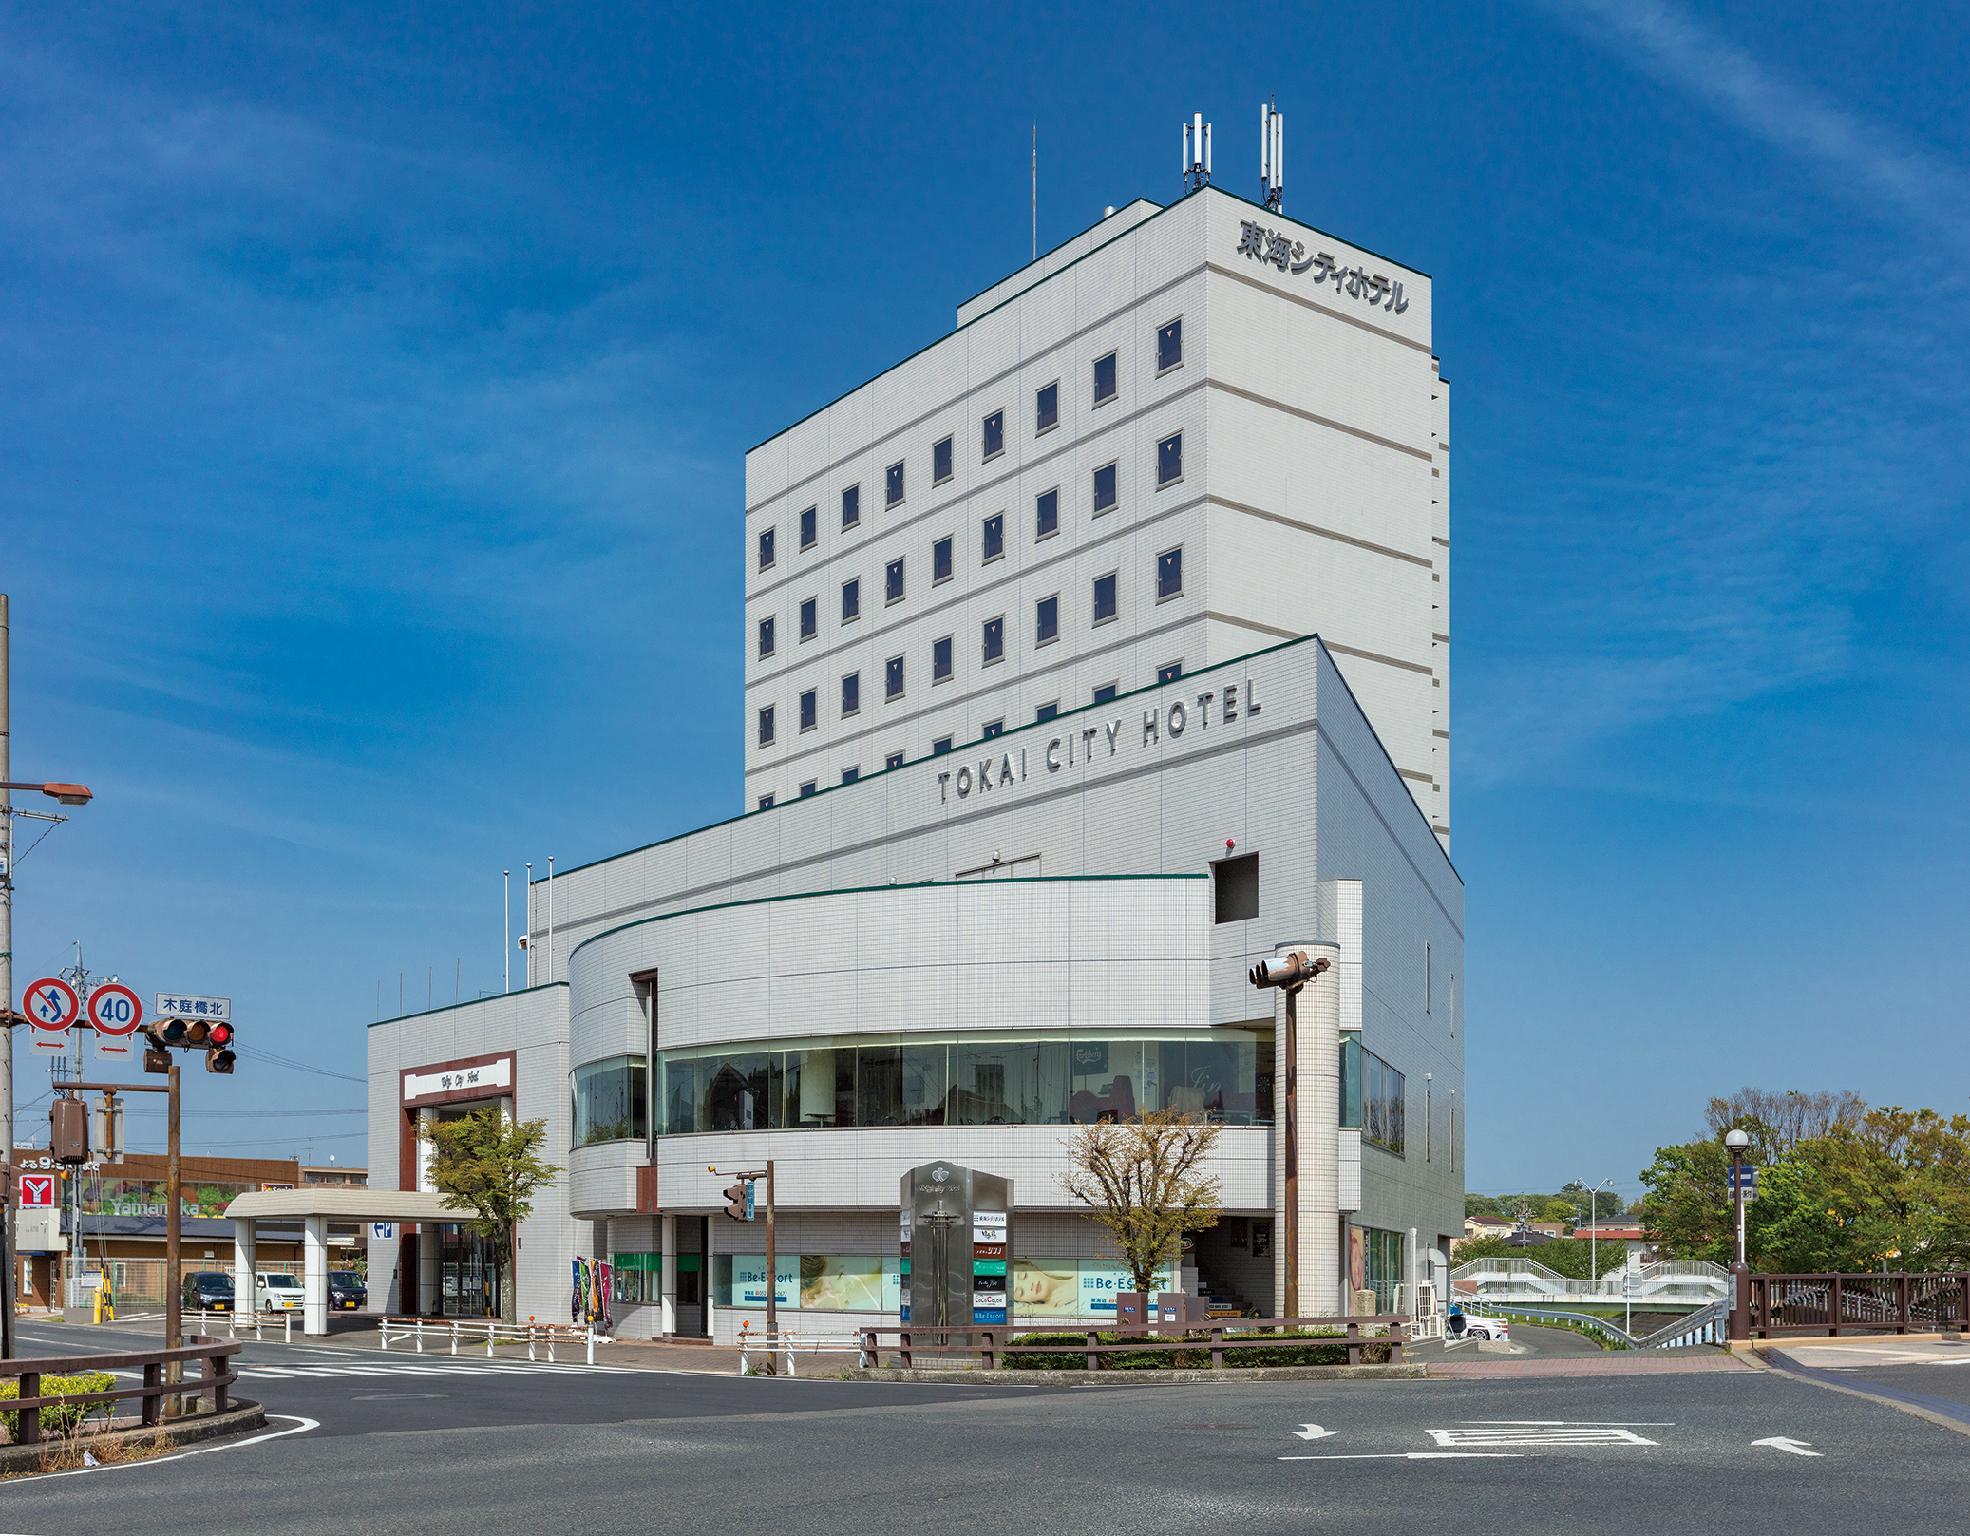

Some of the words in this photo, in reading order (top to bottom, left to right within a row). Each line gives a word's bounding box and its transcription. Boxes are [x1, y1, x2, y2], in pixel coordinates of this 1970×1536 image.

[1237, 219, 1409, 315] 東海シティホテル
[938, 747, 1028, 805] TOKAI
[1046, 718, 1122, 773] CITY
[1143, 679, 1262, 748] HOTEL
[101, 998, 130, 1021] 40
[163, 998, 223, 1015] 木庭橋北
[110, 1197, 200, 1215] Yamanka
